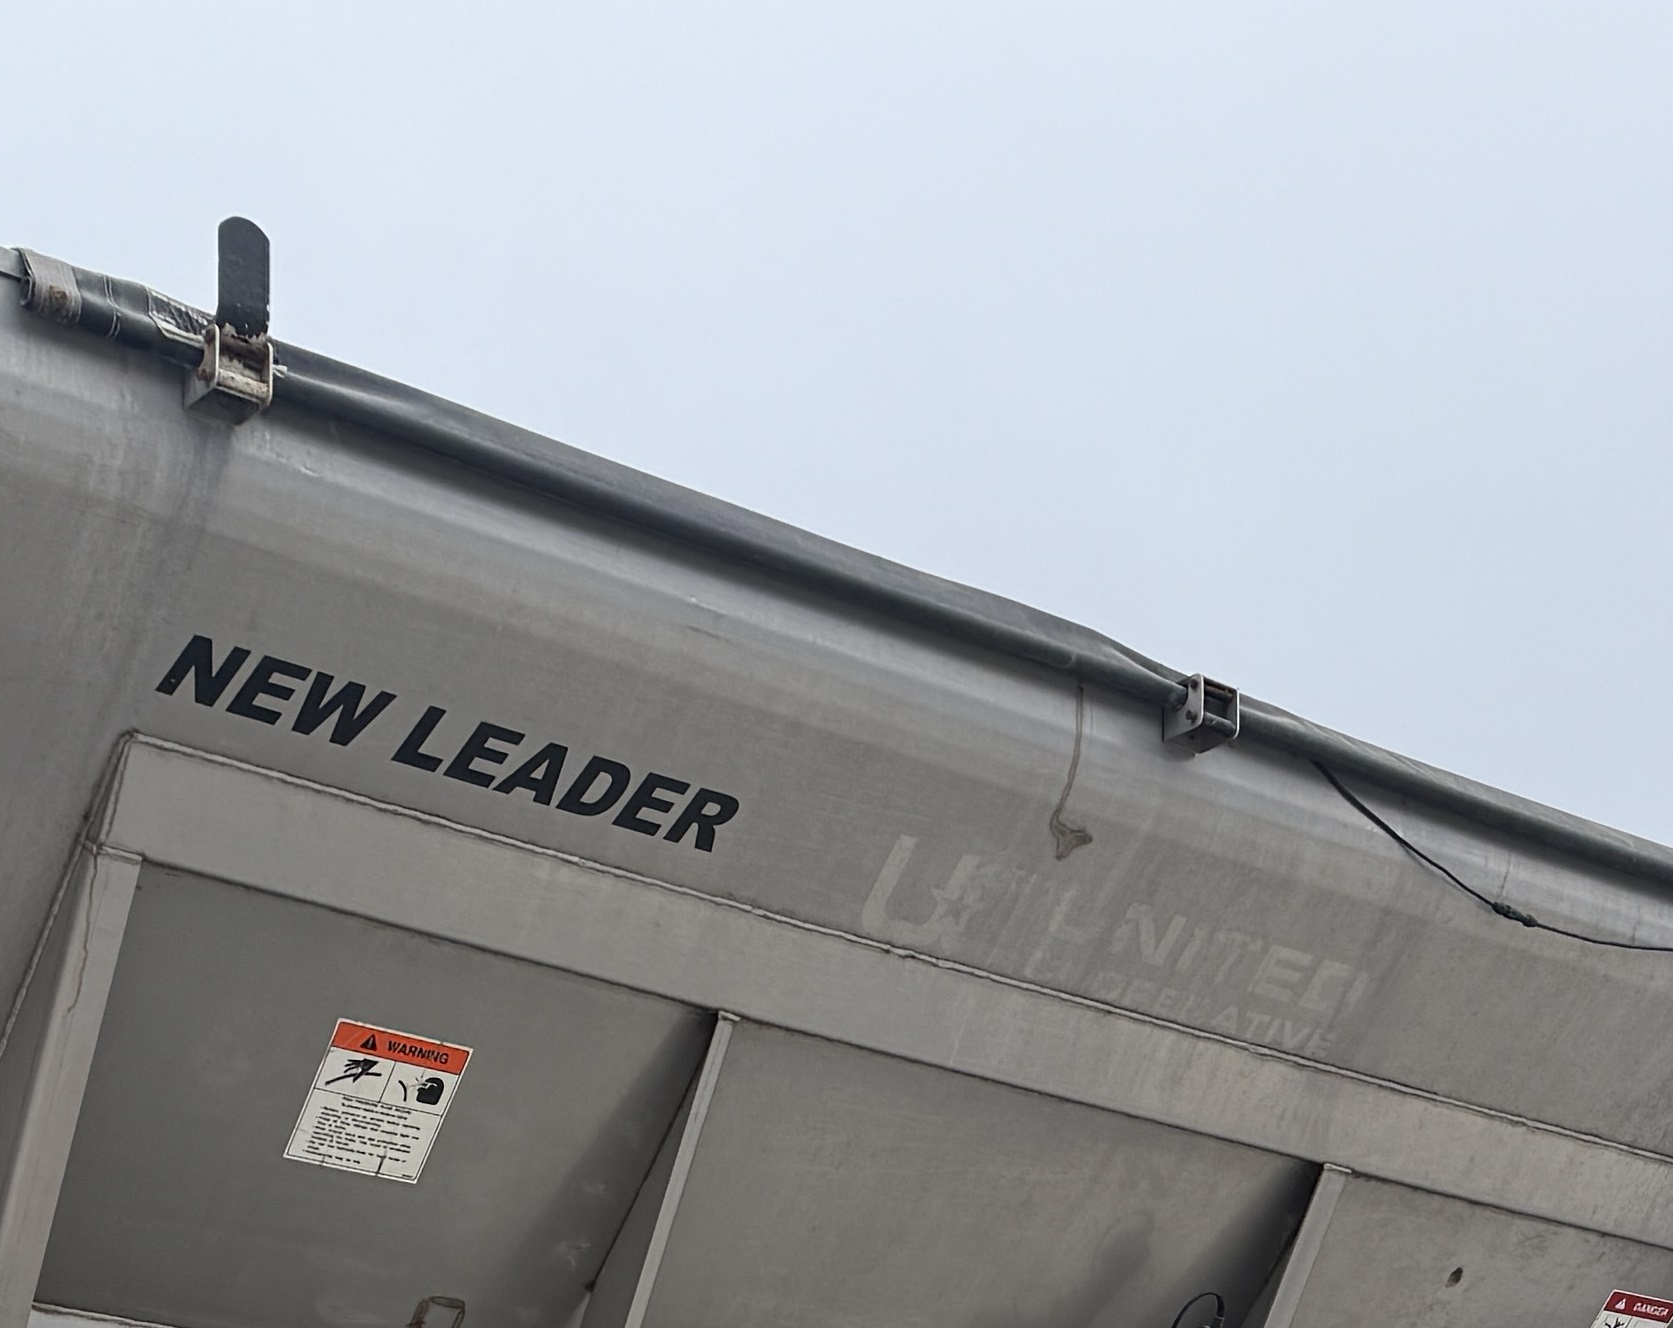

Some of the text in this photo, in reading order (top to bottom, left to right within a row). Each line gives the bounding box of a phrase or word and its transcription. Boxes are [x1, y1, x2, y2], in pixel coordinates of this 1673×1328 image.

[155, 634, 739, 853] NEW LEADER
[387, 1040, 450, 1065] WARNING
